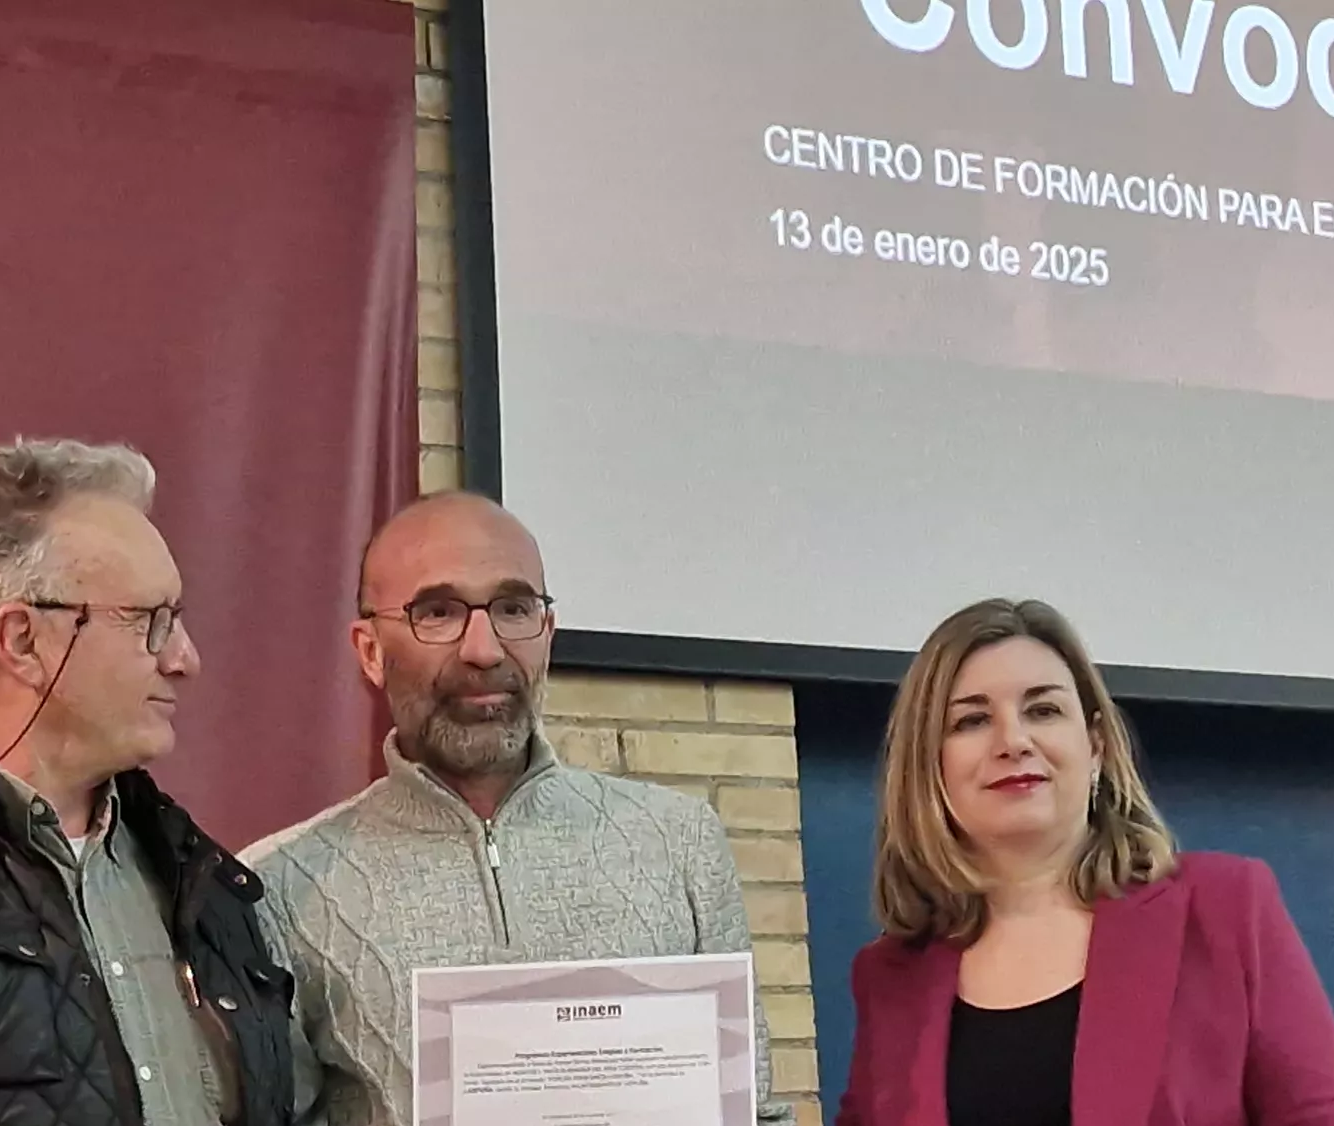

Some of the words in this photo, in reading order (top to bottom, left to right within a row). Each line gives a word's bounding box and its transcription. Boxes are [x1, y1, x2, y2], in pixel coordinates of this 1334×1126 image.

[763, 125, 922, 182] CENTRO
[934, 148, 986, 191] DE
[994, 156, 1208, 221] FORMACIÓN
[1218, 188, 1310, 235] PARA
[769, 208, 813, 250] 13
[821, 215, 864, 256] de
[874, 229, 969, 269] enero
[979, 236, 1020, 275] de
[1028, 242, 1110, 286] 2025
